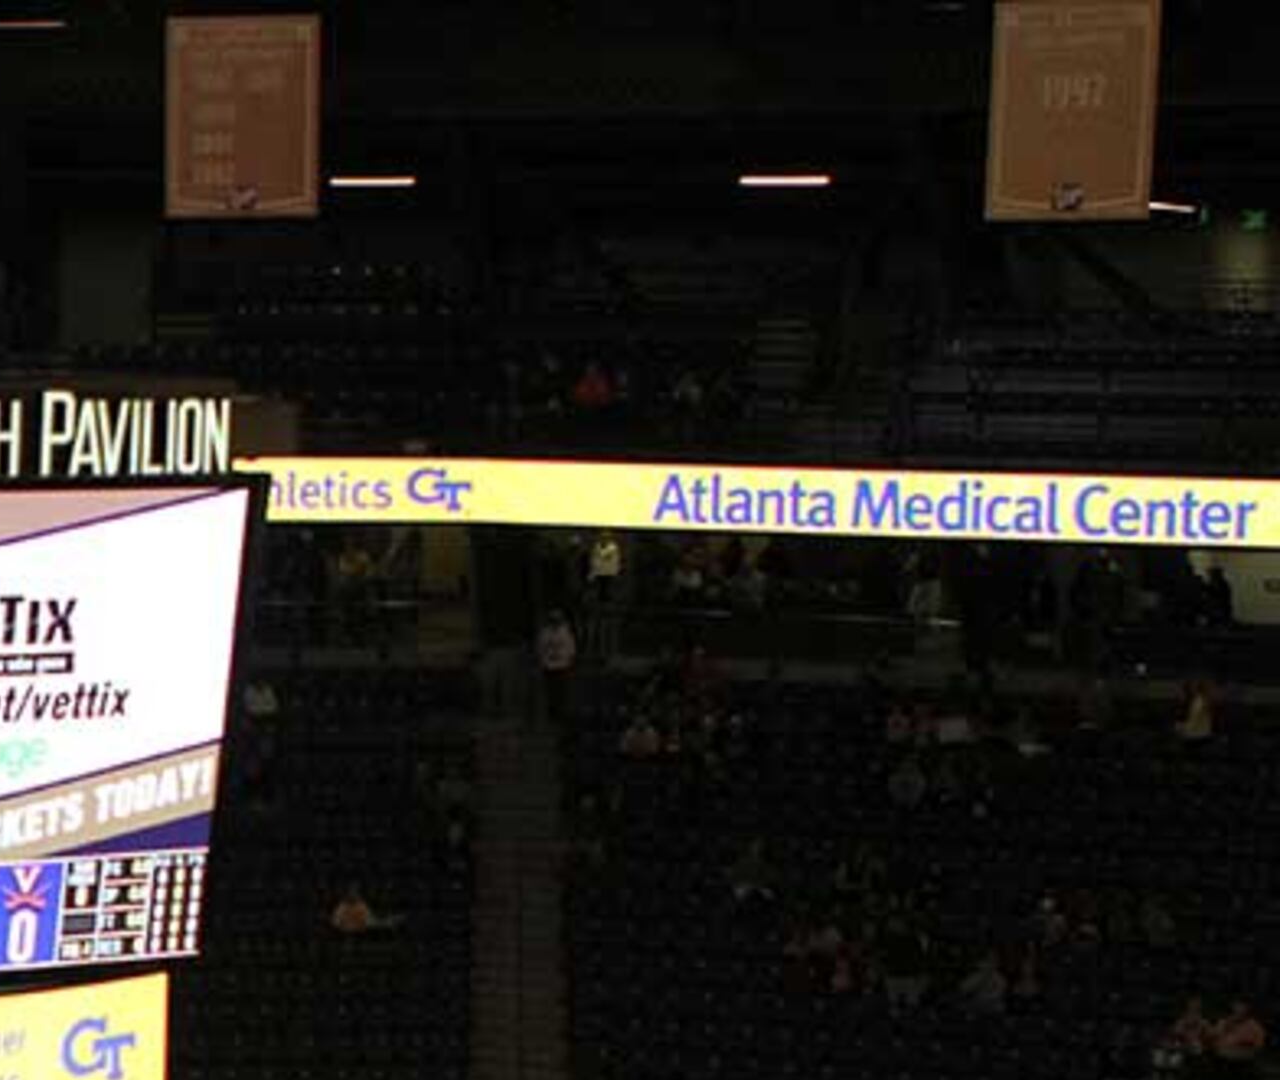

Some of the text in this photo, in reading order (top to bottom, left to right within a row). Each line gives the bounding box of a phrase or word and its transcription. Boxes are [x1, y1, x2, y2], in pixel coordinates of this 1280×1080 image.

[271, 467, 472, 512] hletics GT
[653, 472, 1257, 539] Atlanta Medical Center
[0, 595, 77, 645] TIX
[95, 757, 215, 821] TODAY!
[7, 909, 38, 964] 0
